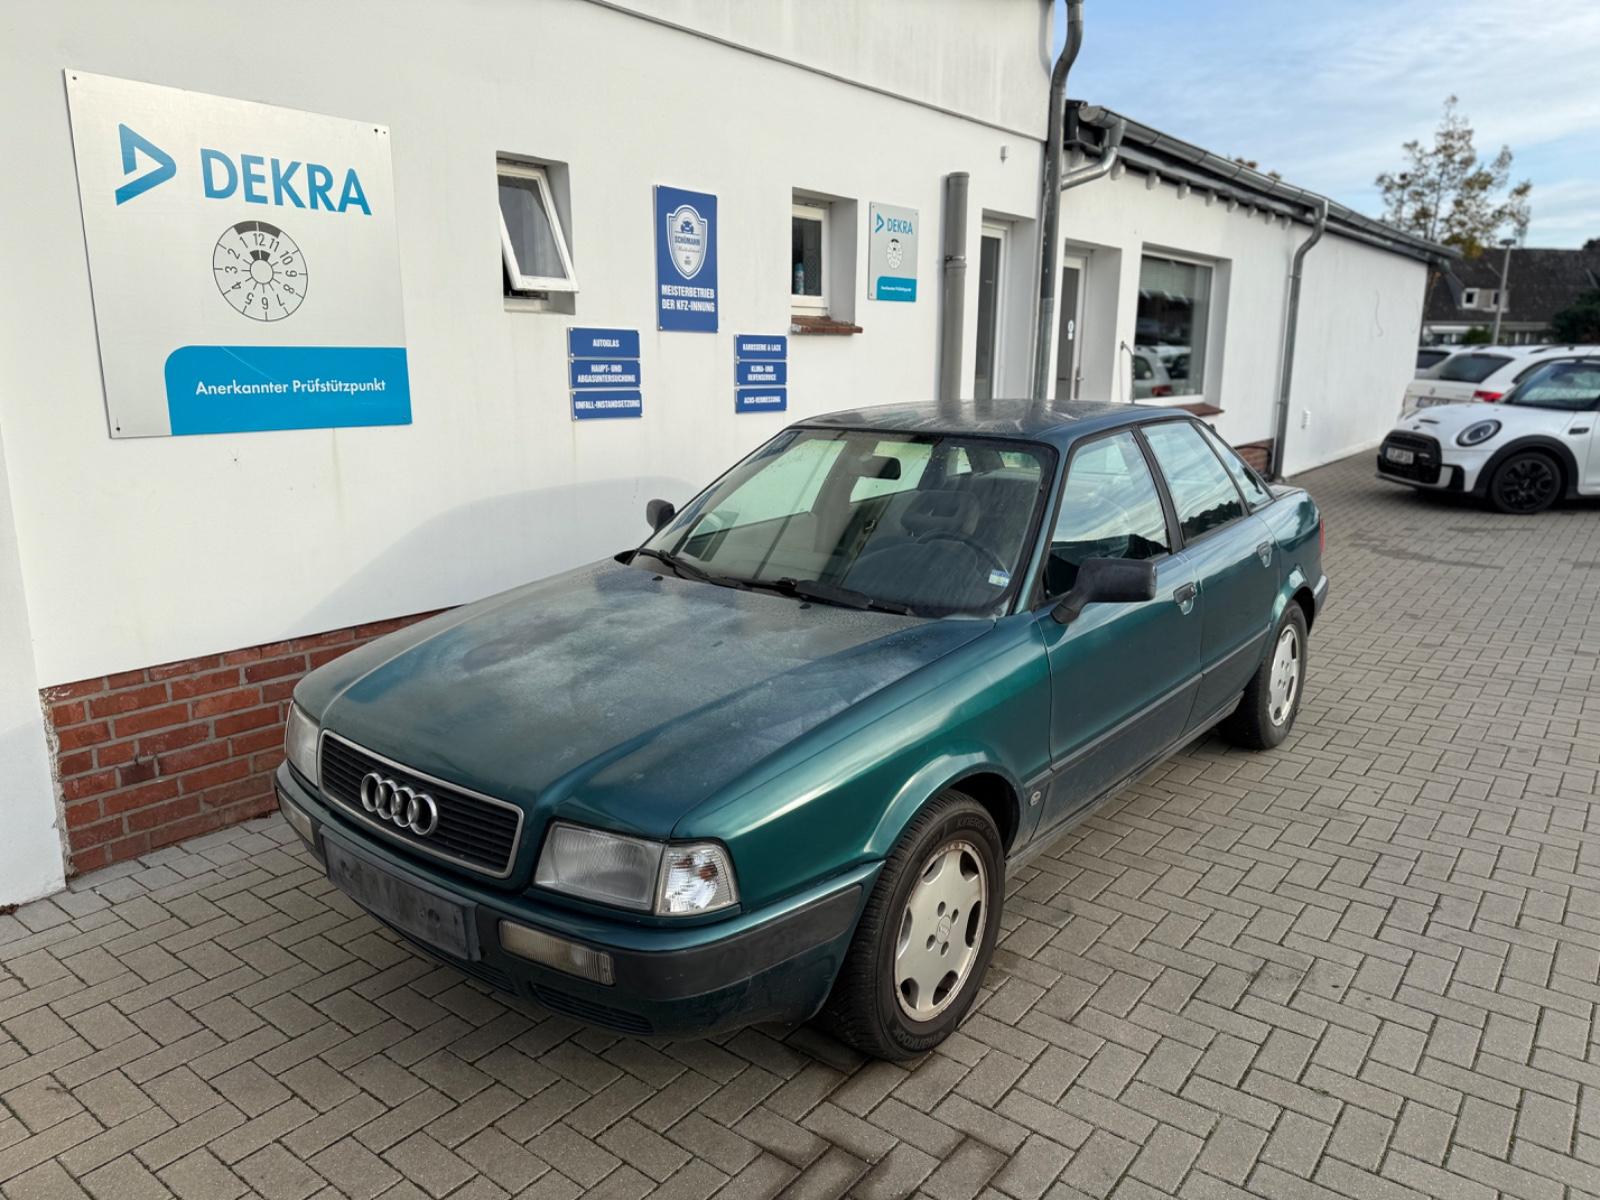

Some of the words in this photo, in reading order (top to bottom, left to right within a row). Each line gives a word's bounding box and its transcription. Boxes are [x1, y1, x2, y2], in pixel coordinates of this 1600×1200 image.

[200, 148, 372, 215] DEKRA
[887, 218, 913, 235] DEKRA
[239, 235, 249, 249] 1
[252, 232, 266, 247] 12
[269, 238, 280, 253] 11
[226, 247, 241, 260] 2
[279, 250, 294, 266] 10
[224, 265, 239, 275] 3
[231, 281, 242, 290] 4
[282, 283, 296, 295] 8
[661, 284, 714, 299] MEISTERBETRIEB
[244, 292, 255, 306] 5
[276, 293, 286, 307] 7
[661, 298, 675, 310] DER
[676, 299, 715, 312] KFZ-INNUNG
[593, 339, 619, 347] AUTOGLAS
[591, 364, 609, 372] HAUPT-
[611, 364, 622, 372] UND
[578, 375, 635, 383] ABGASUNTERSUCHUNG
[195, 379, 289, 396] Anerkannter
[292, 377, 386, 396] Prüfstützpunkt
[575, 400, 640, 409] UNFALL-INSTANDSETZUNG
